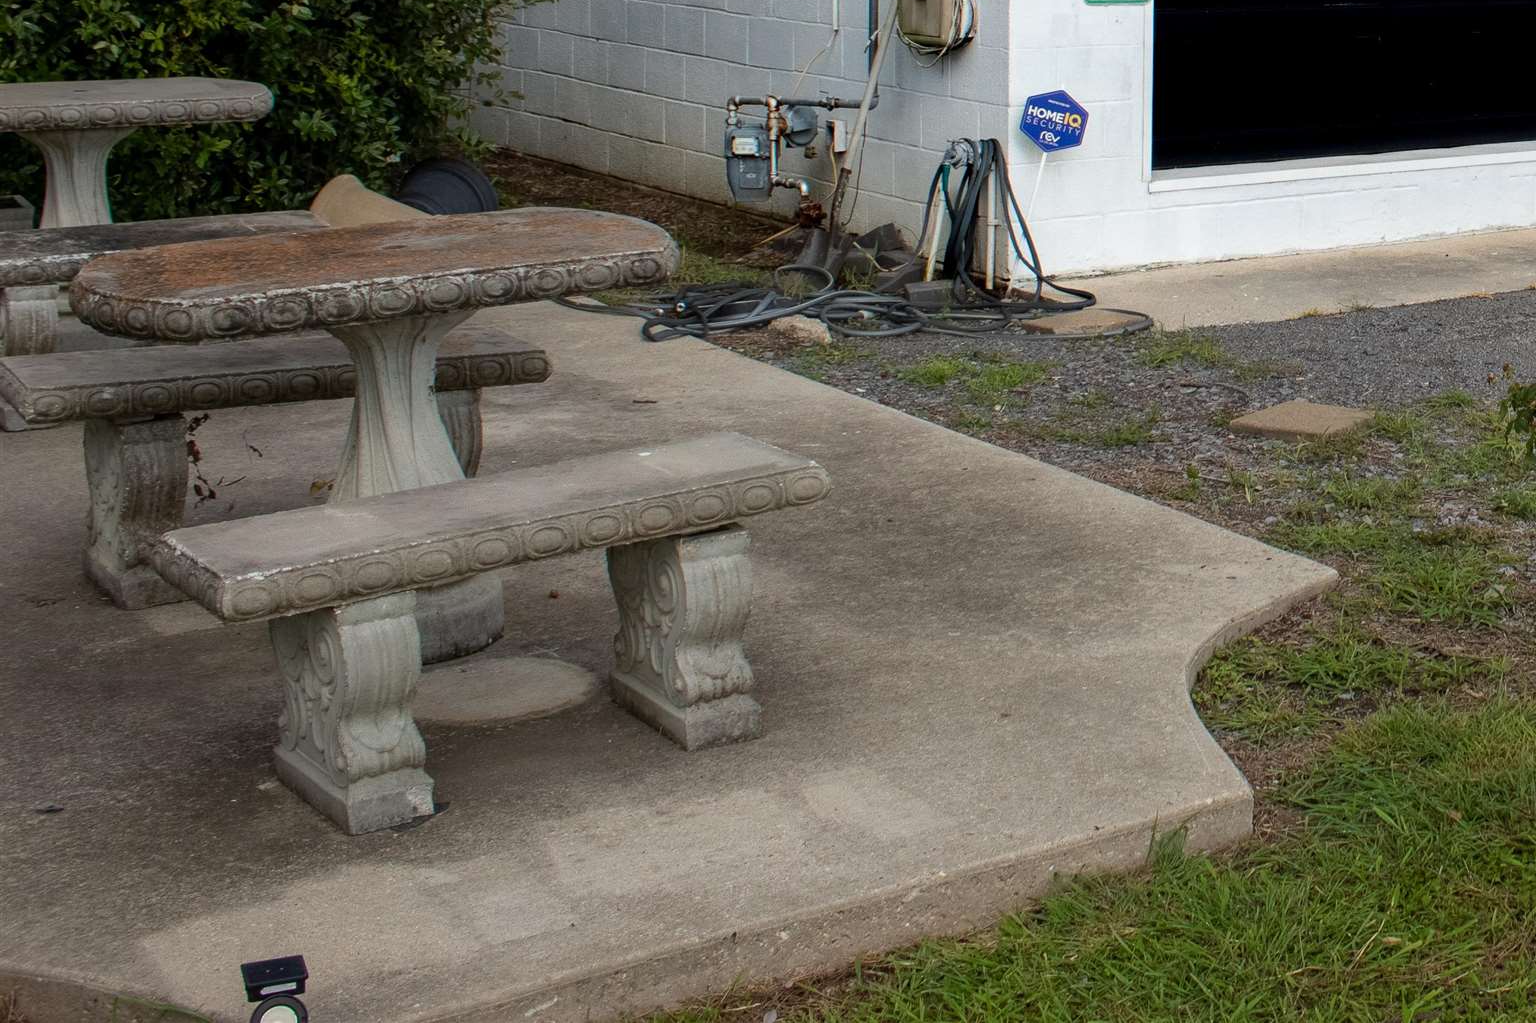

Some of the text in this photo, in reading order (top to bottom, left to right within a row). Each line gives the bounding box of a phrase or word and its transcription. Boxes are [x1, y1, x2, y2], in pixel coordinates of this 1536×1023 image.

[1025, 116, 1081, 136] SECURITY
[1027, 105, 1082, 128] HOMEIQ
[1040, 130, 1061, 143] rev
